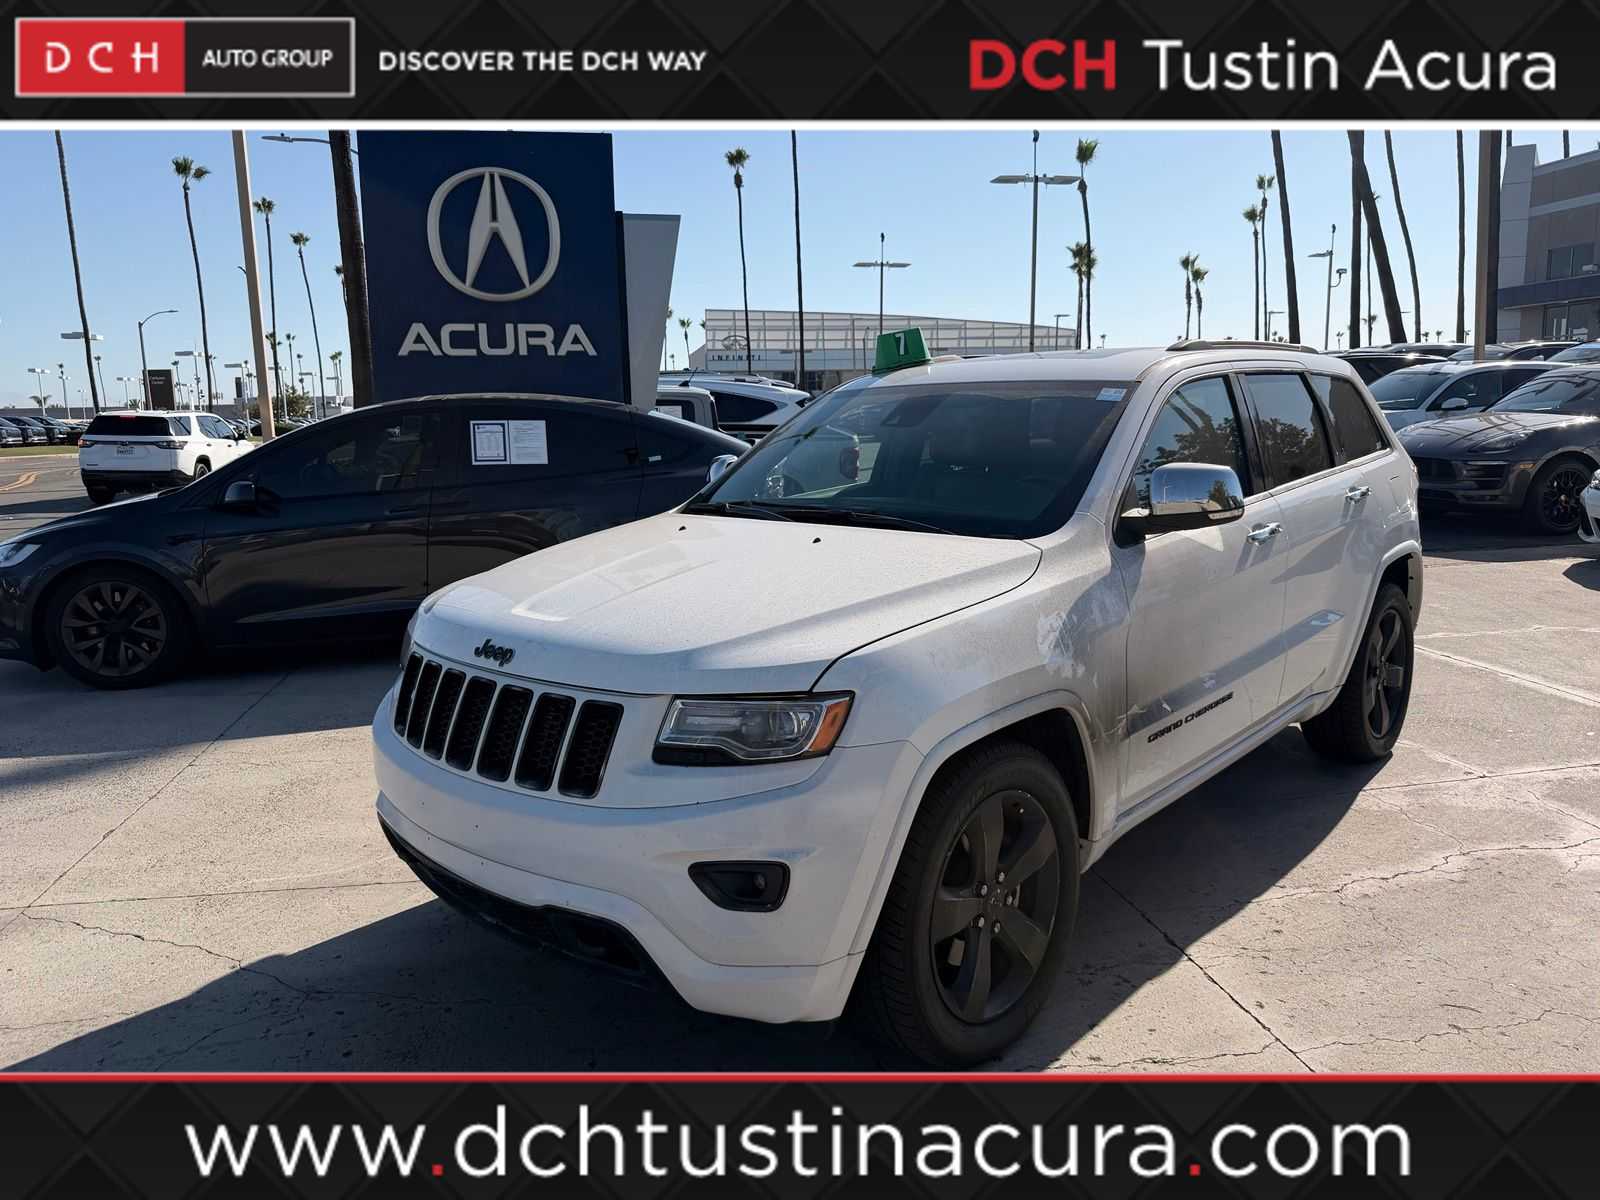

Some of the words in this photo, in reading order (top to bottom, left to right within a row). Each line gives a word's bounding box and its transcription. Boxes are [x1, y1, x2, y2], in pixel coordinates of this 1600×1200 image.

[398, 322, 597, 356] ACURA
[474, 638, 514, 667] Jeep
[1147, 719, 1183, 743] GRAND
[1184, 691, 1234, 723] CHEROKEE
